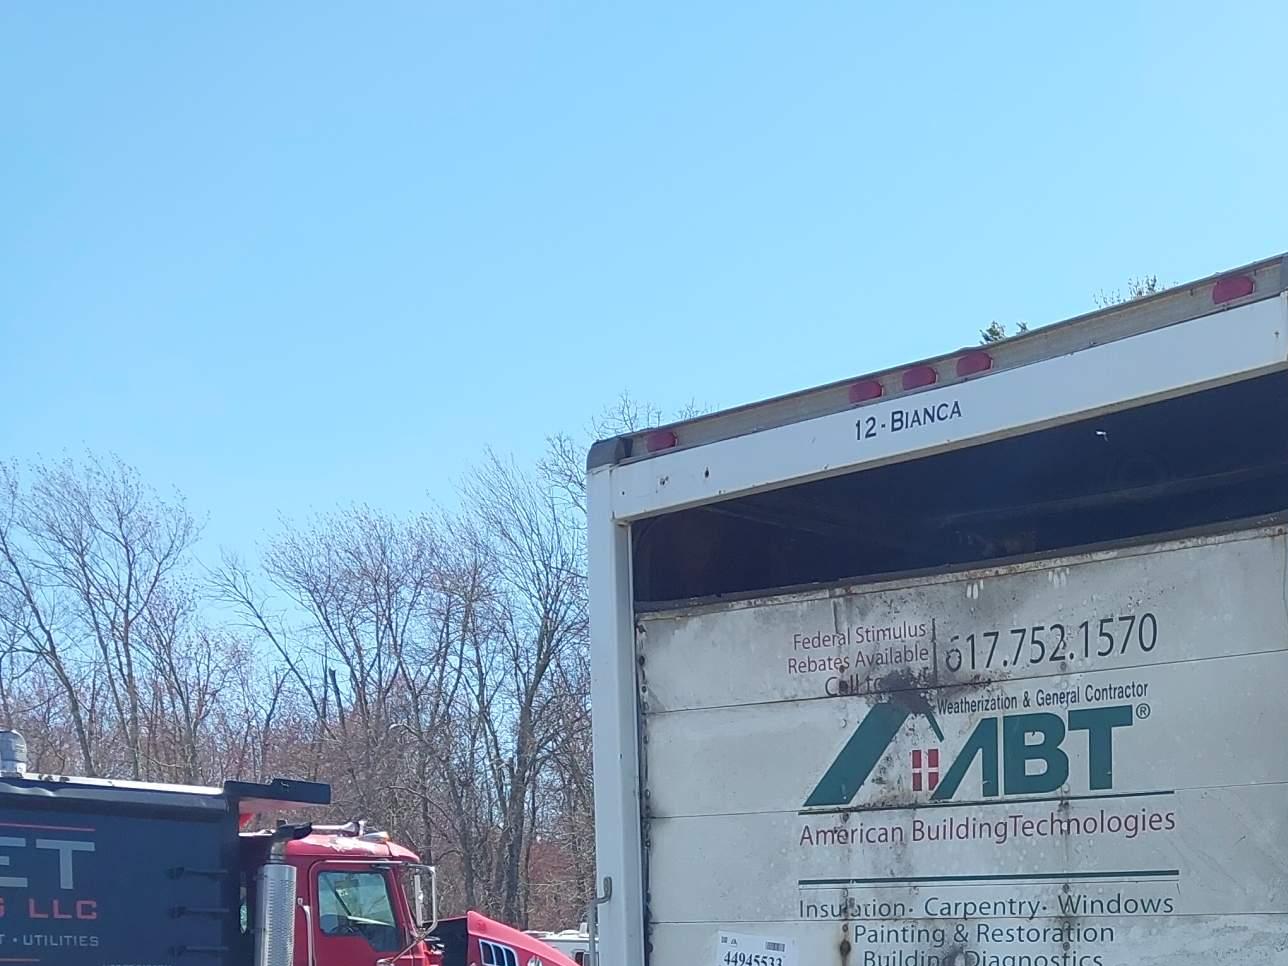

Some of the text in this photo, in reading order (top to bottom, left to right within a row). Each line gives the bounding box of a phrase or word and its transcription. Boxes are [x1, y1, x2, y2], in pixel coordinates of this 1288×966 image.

[794, 621, 926, 650] Federal Stimulus
[946, 613, 1157, 672] 617.752.1570
[788, 643, 929, 674] Rebates Available
[937, 680, 1149, 715] Weatherization & General Contractor
[800, 823, 903, 847] American
[29, 898, 97, 919] LLC
[924, 897, 1040, 920] Carpentry
[1058, 893, 1173, 915] Windows
[23, 935, 99, 947] UTILITIES
[854, 923, 1114, 948] Painting & Restoration
